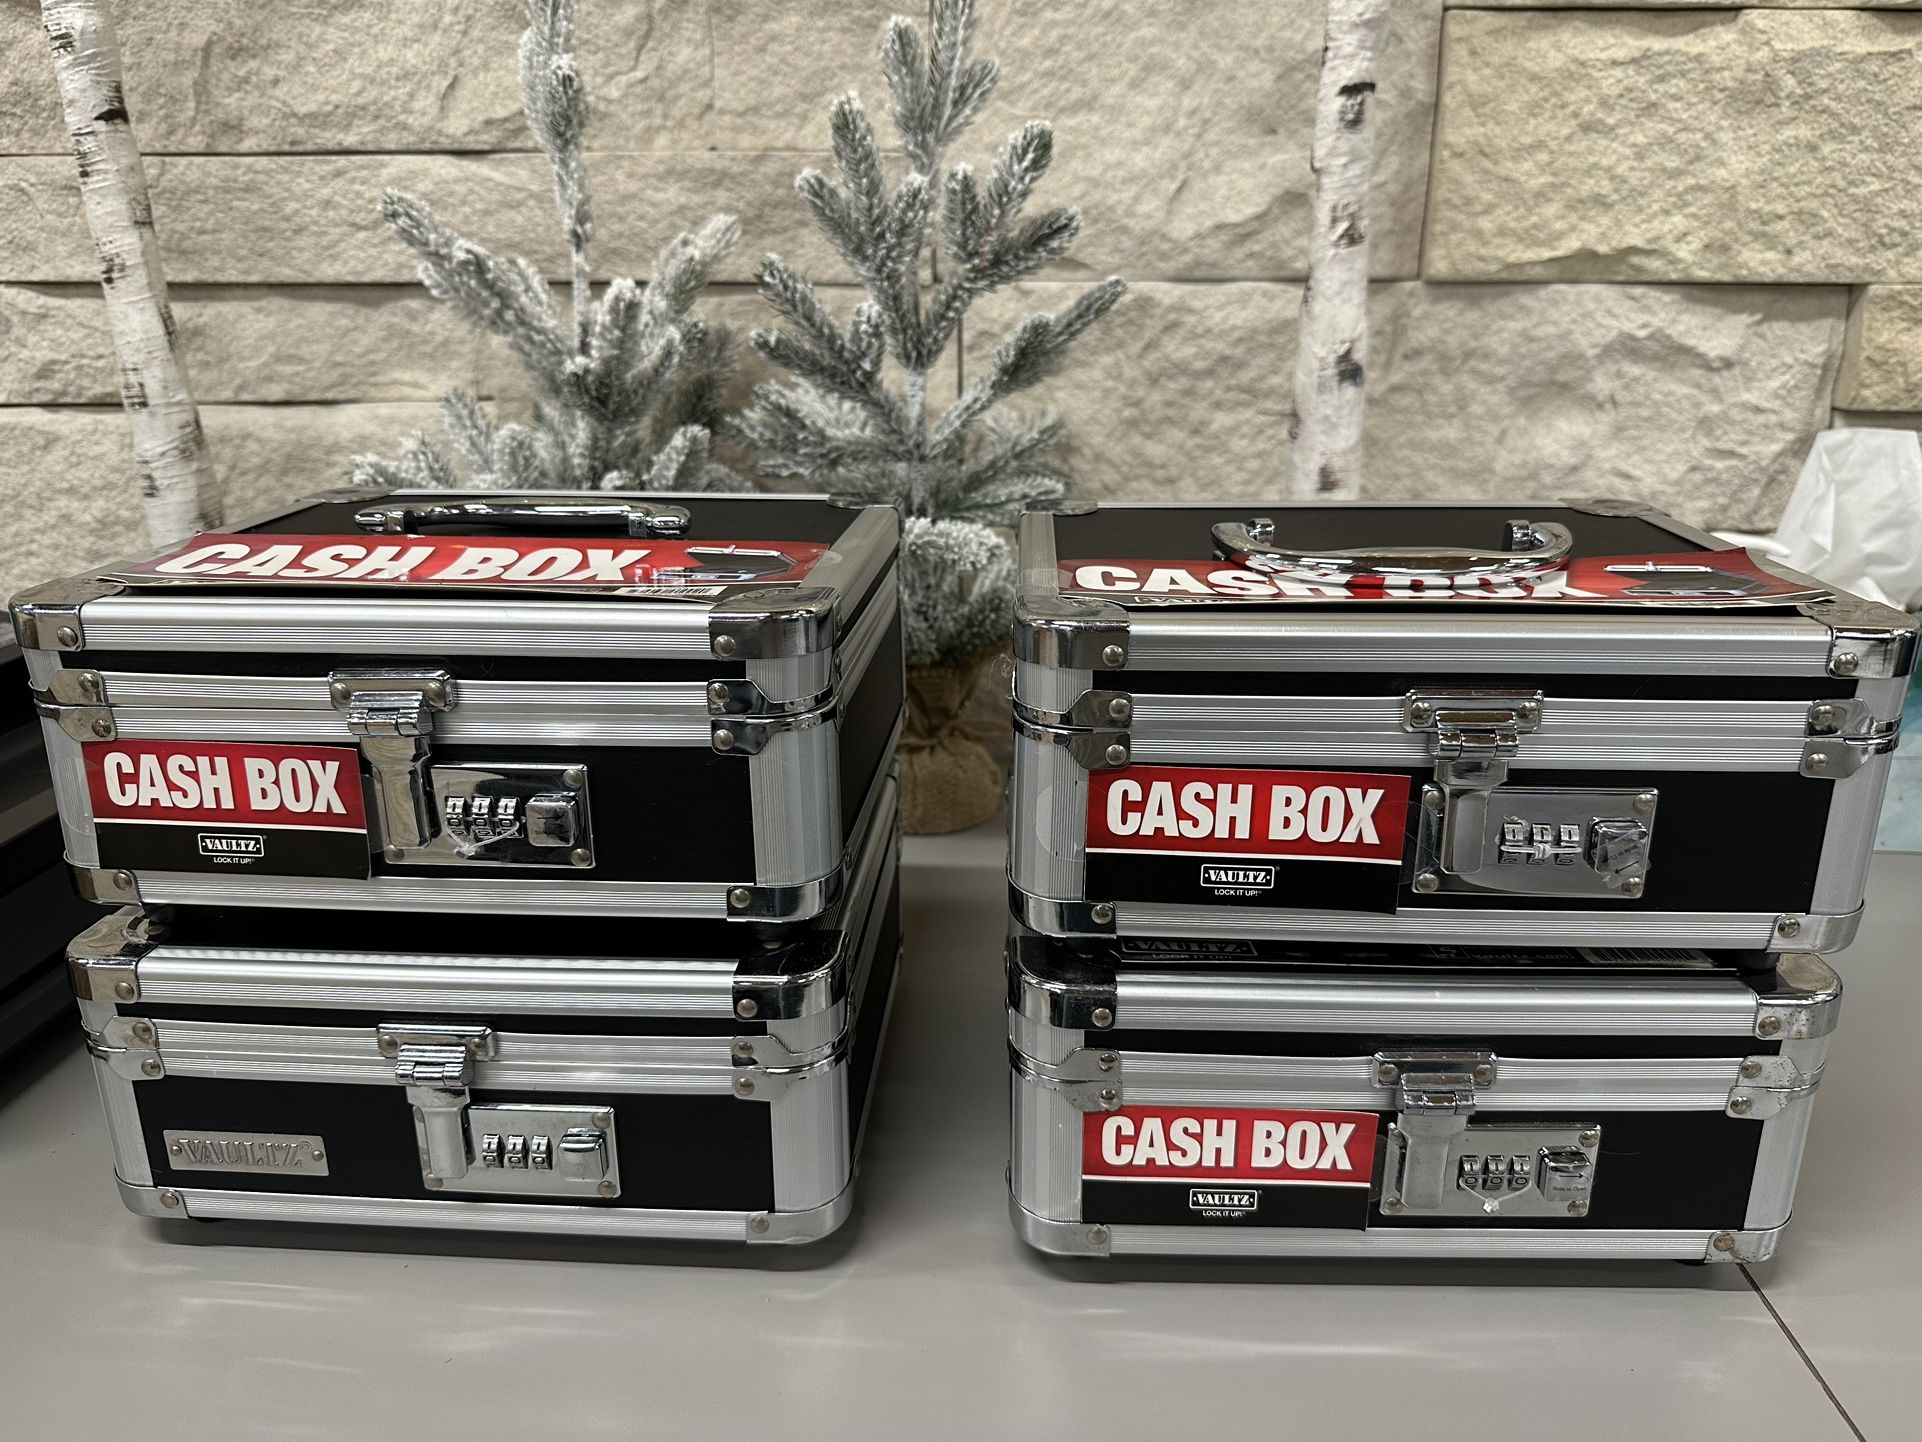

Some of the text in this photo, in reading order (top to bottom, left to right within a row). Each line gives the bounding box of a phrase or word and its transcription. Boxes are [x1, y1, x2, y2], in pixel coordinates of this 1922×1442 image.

[154, 543, 652, 581] CASH BOX
[103, 752, 347, 814] CASH BOX
[1106, 779, 1385, 845] CASH BOX
[204, 838, 257, 851] VAULTZ
[1208, 869, 1266, 883] VAULTZ
[178, 1138, 304, 1168] VAULTZ
[1101, 1115, 1356, 1171] CASH BOX
[1196, 1193, 1250, 1205] VAULTZ
